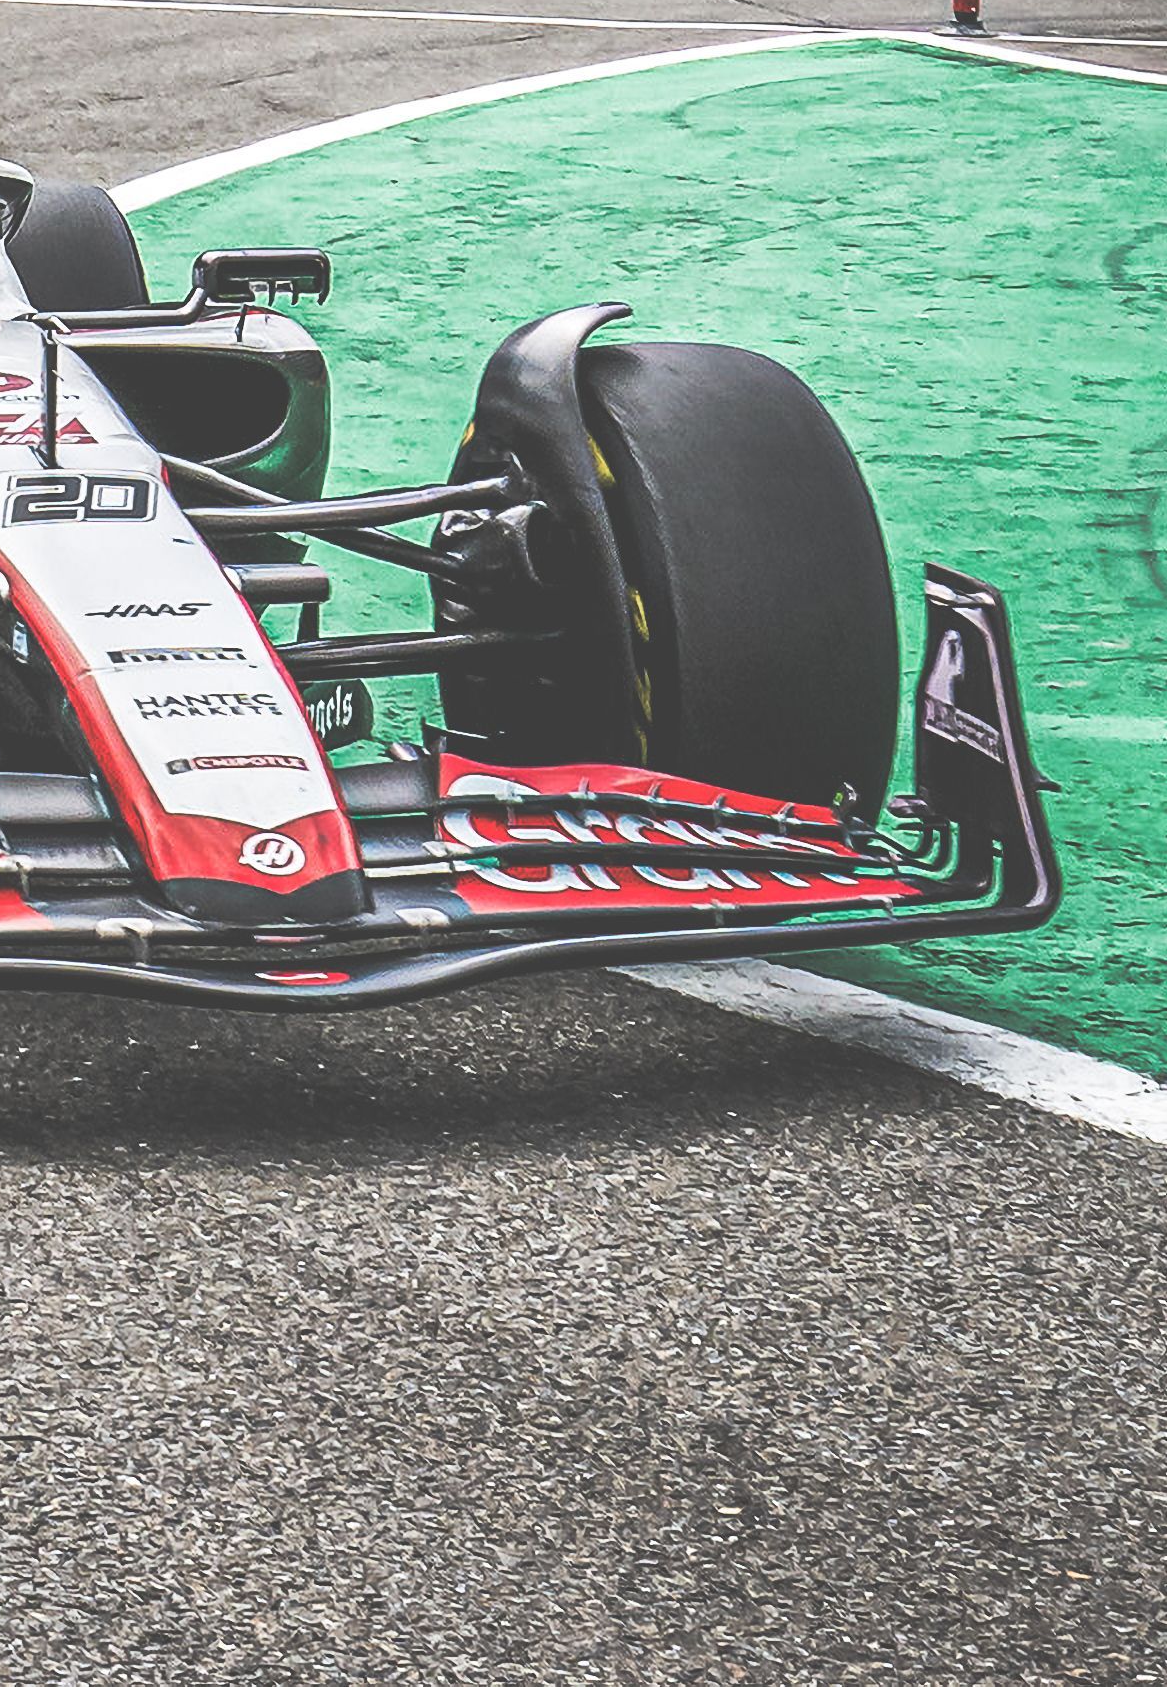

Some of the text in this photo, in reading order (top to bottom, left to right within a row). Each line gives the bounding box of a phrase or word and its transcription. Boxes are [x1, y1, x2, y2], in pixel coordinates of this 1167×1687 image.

[2, 474, 159, 528] 20
[84, 602, 213, 618] HAAS
[133, 693, 278, 710] HANTEC
[306, 685, 353, 739] ngels
[195, 756, 307, 770] CHIPOTLE
[441, 773, 861, 892] Gram
